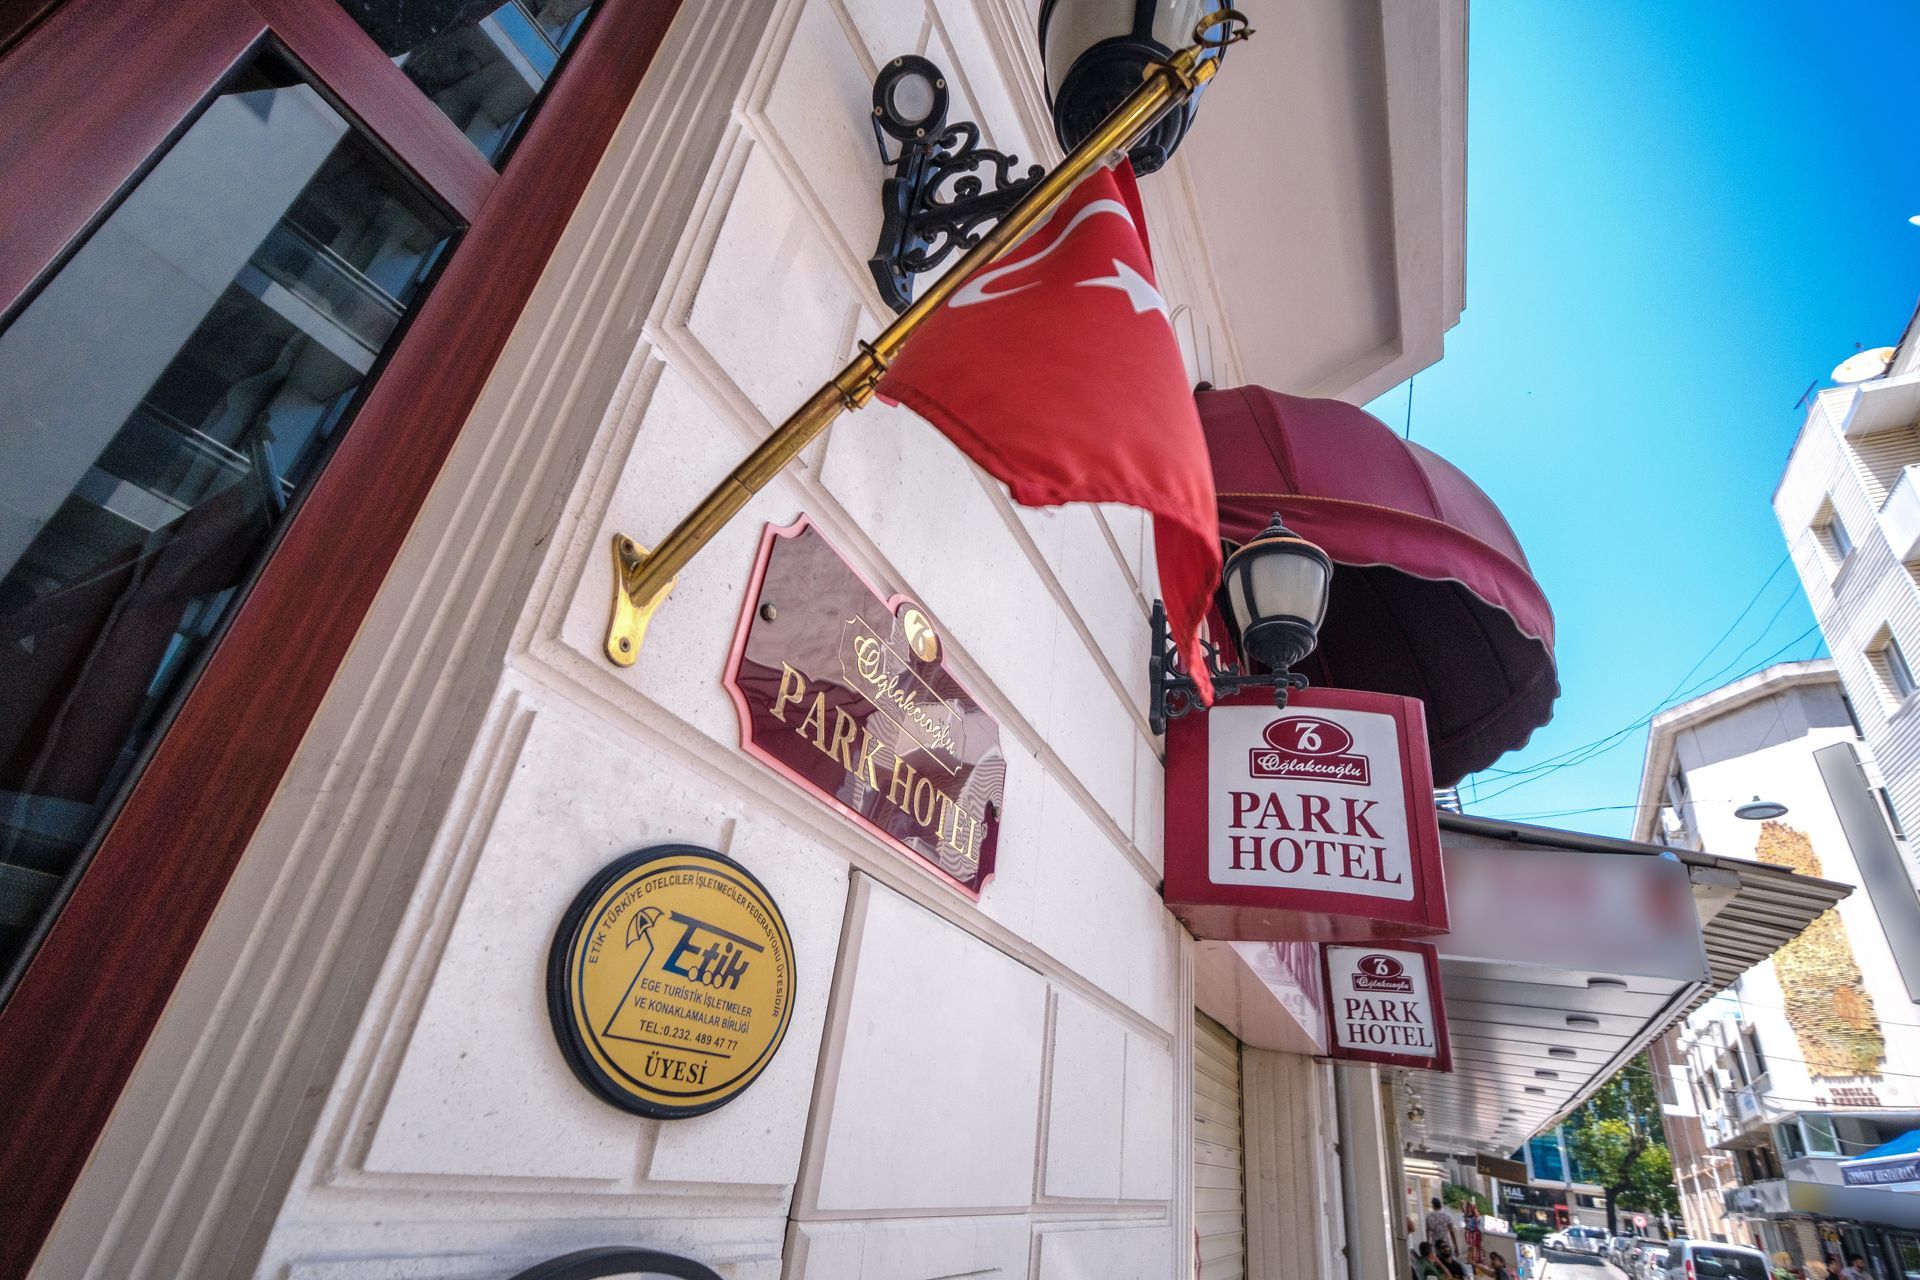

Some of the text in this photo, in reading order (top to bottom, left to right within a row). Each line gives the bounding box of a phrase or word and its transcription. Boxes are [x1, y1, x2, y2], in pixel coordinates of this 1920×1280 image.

[1295, 722, 1322, 751] 76
[769, 661, 980, 864] PARK HOTEL
[1258, 753, 1362, 778] Oğlakcıoğlu
[1228, 791, 1384, 840] PARK
[1228, 836, 1402, 884] HOTEL
[589, 934, 606, 964] ETİK
[603, 887, 643, 929] TÜRKİYE
[695, 872, 747, 908] İŞLETMECİLER
[746, 901, 781, 962] FEDERASYONU
[662, 913, 756, 990] Etik
[1373, 958, 1388, 975] 76
[634, 996, 750, 1034] VE KONAKLAMALAR BİRLİĞİ
[641, 978, 752, 1018] EGE TURİSTİK İŞLETMELER
[1344, 998, 1422, 1024] PARK
[640, 1019, 738, 1051] TEL:0.232. 489 47 77
[1346, 1023, 1433, 1048] HOTEL
[644, 1050, 708, 1084] ÜYESİ
